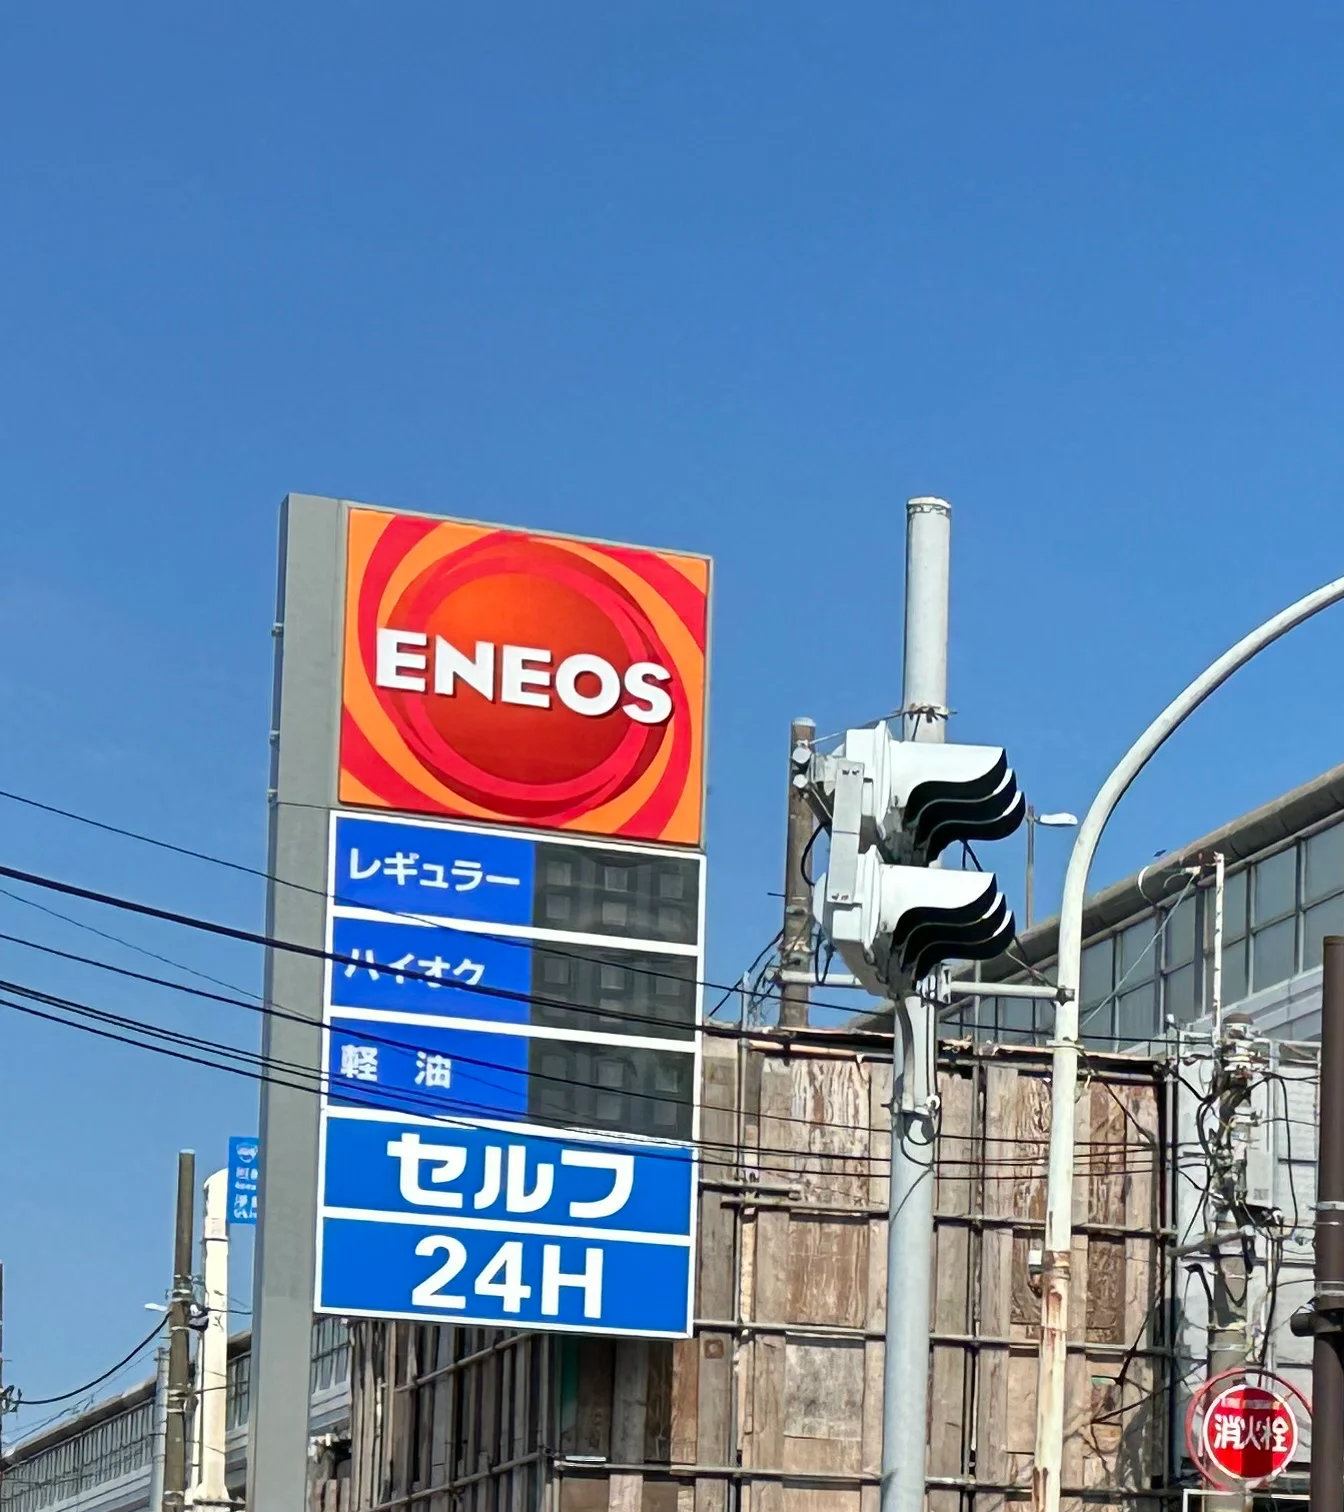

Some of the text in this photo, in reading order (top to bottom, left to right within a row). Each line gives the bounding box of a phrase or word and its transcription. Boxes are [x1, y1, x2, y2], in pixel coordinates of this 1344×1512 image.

[376, 627, 673, 725] ENEOS
[350, 846, 521, 894] レギュラー
[343, 947, 487, 990] ハイオク
[387, 1131, 634, 1218] セルフ
[411, 1235, 605, 1319] 24H
[1214, 1413, 1289, 1453] 消火栓
